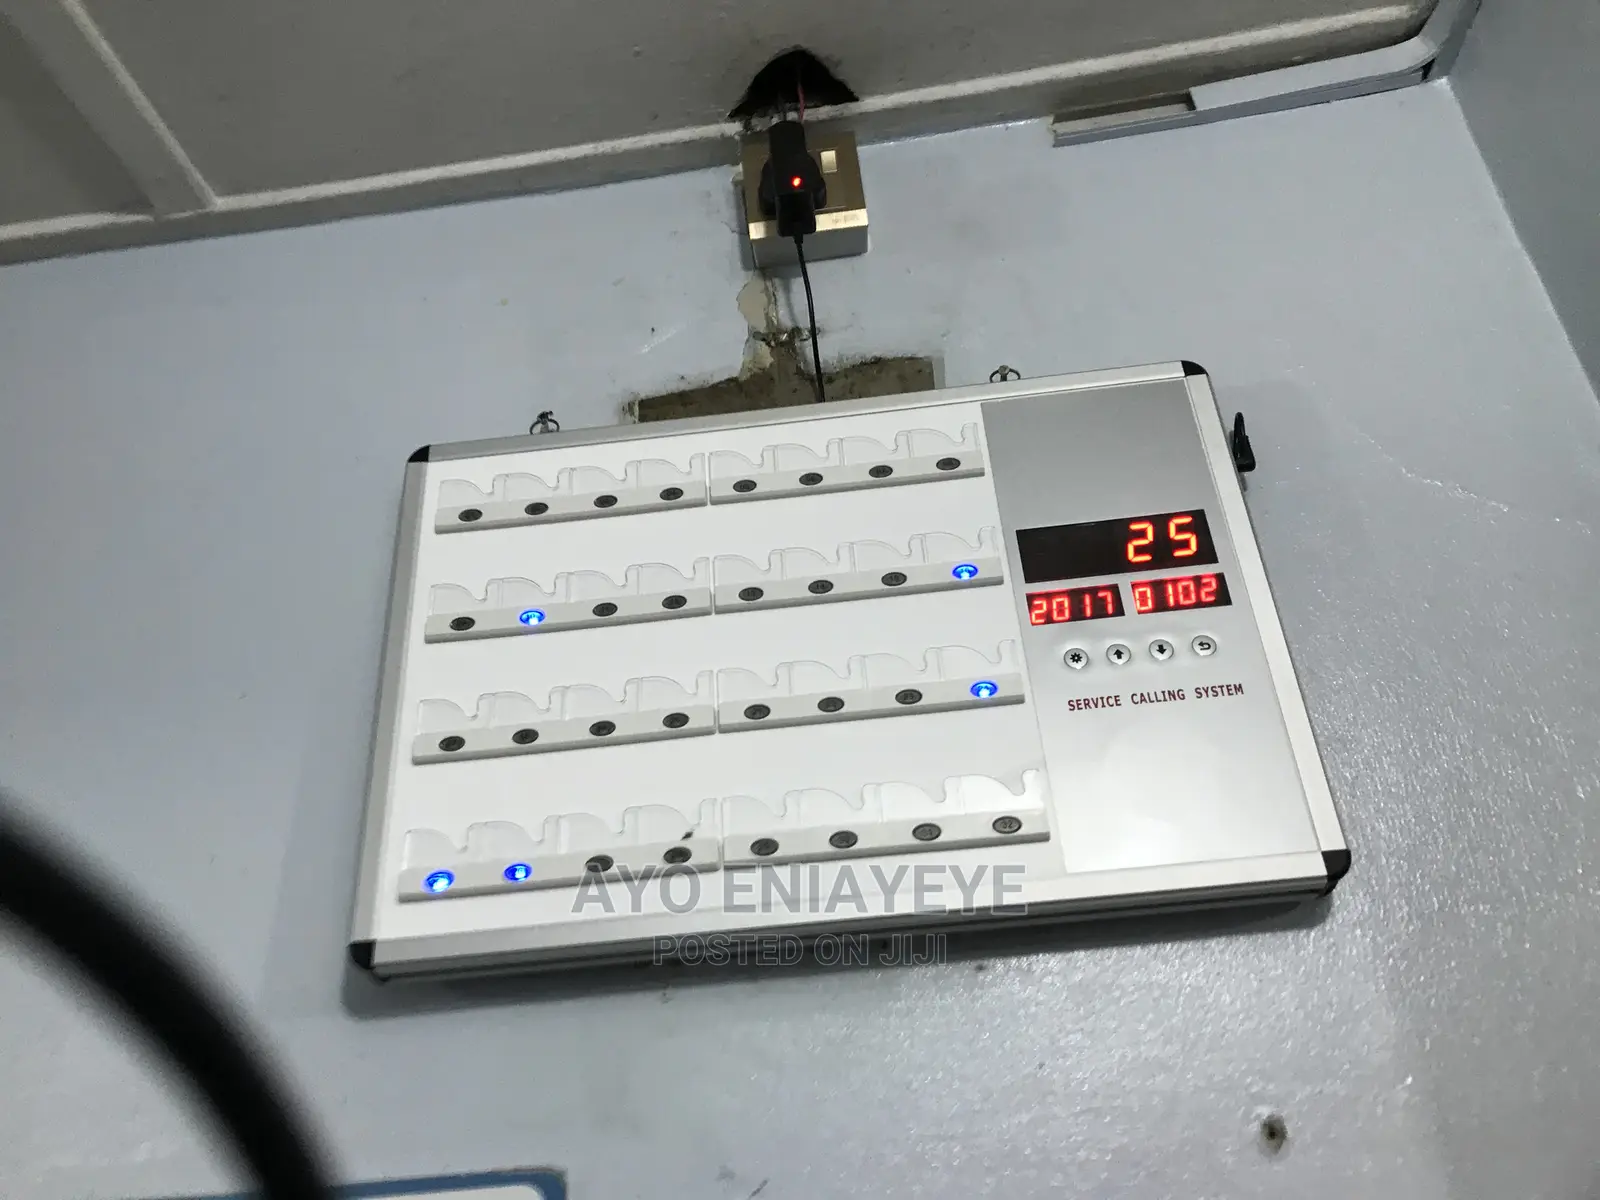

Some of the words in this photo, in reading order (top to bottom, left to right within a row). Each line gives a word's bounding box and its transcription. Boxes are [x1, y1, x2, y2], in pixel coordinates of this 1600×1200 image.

[1127, 515, 1198, 563] 25
[1031, 590, 1114, 624] 2017
[1134, 577, 1217, 611] 0102
[1067, 694, 1122, 711] SERVICE
[1130, 688, 1186, 705] CALLING
[1194, 683, 1245, 699] SYSTEM
